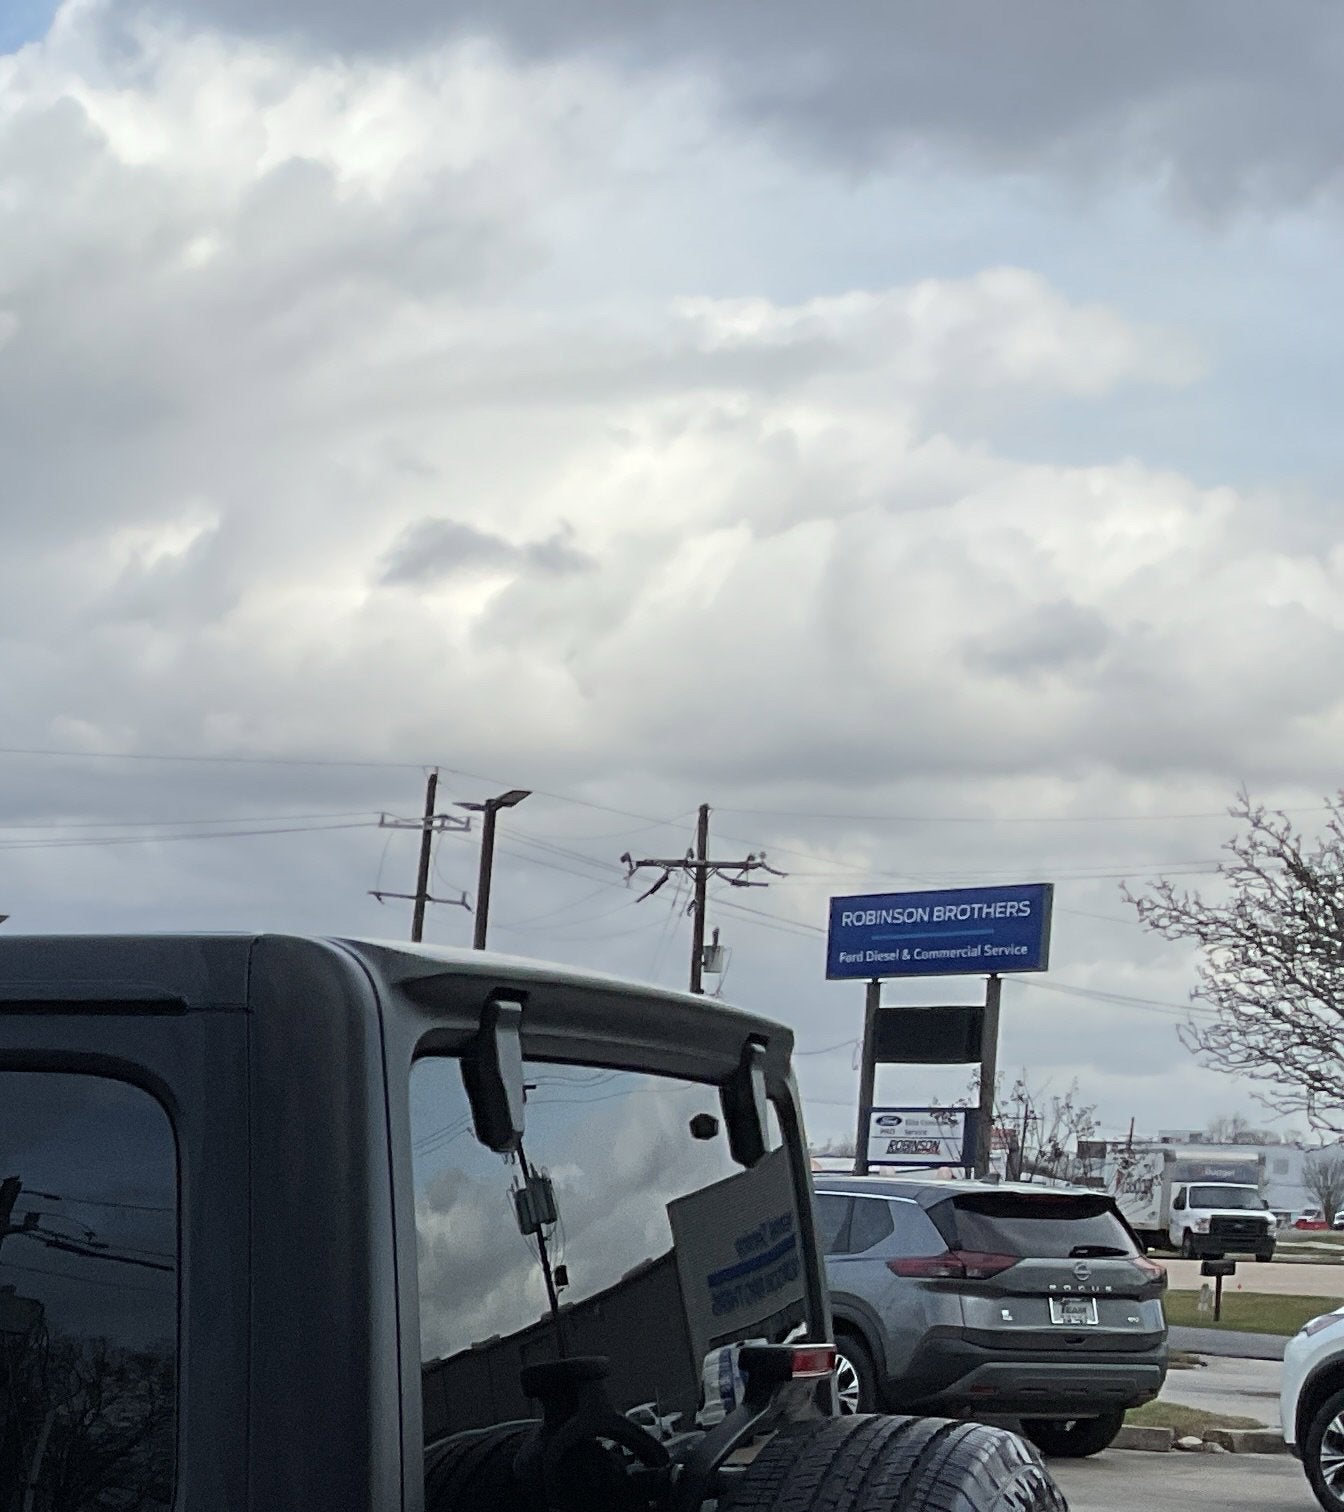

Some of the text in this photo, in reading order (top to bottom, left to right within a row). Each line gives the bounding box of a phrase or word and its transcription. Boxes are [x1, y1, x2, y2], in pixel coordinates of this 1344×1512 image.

[840, 900, 1032, 927] ROBINSON BROTHERS
[838, 942, 1029, 964] Ford Diesel & Commercial Service
